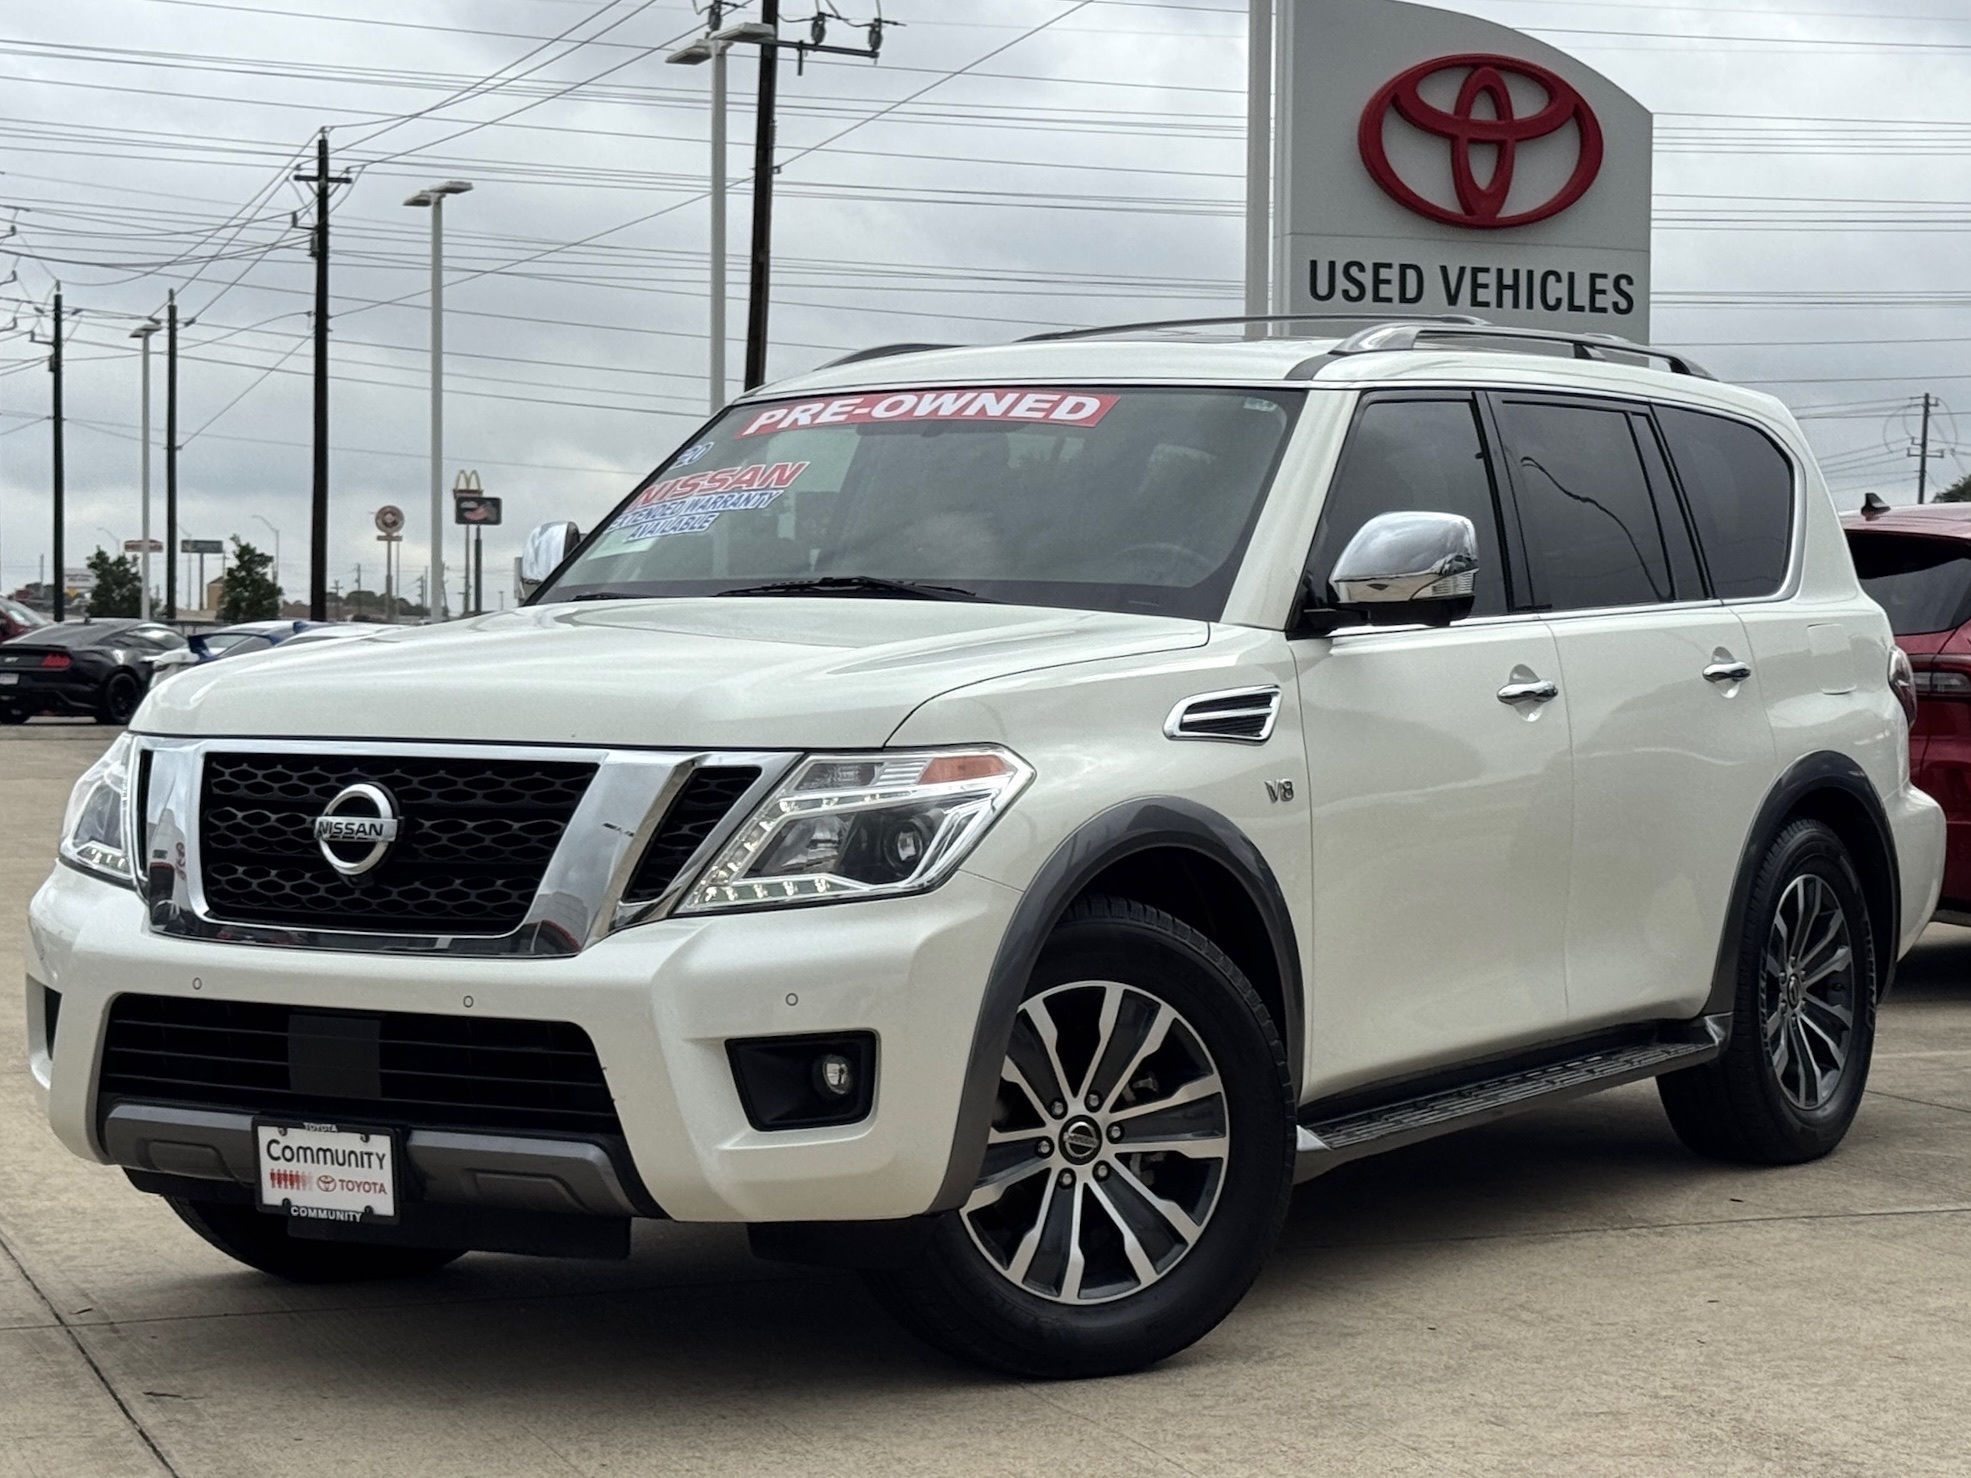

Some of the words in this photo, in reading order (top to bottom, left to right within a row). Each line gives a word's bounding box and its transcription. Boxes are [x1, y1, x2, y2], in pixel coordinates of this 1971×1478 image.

[1308, 259, 1425, 305] USED
[1438, 265, 1635, 315] VEHICLES
[741, 391, 1102, 436] PRE-OWNED
[627, 462, 810, 511] NISSAN
[683, 490, 780, 513] WARRANTY
[627, 513, 718, 539] AVAILABLE
[1264, 778, 1295, 803] V8
[318, 820, 384, 838] NISSAN
[338, 1179, 387, 1195] TOYOTA
[291, 1206, 362, 1222] COMMUNITY
